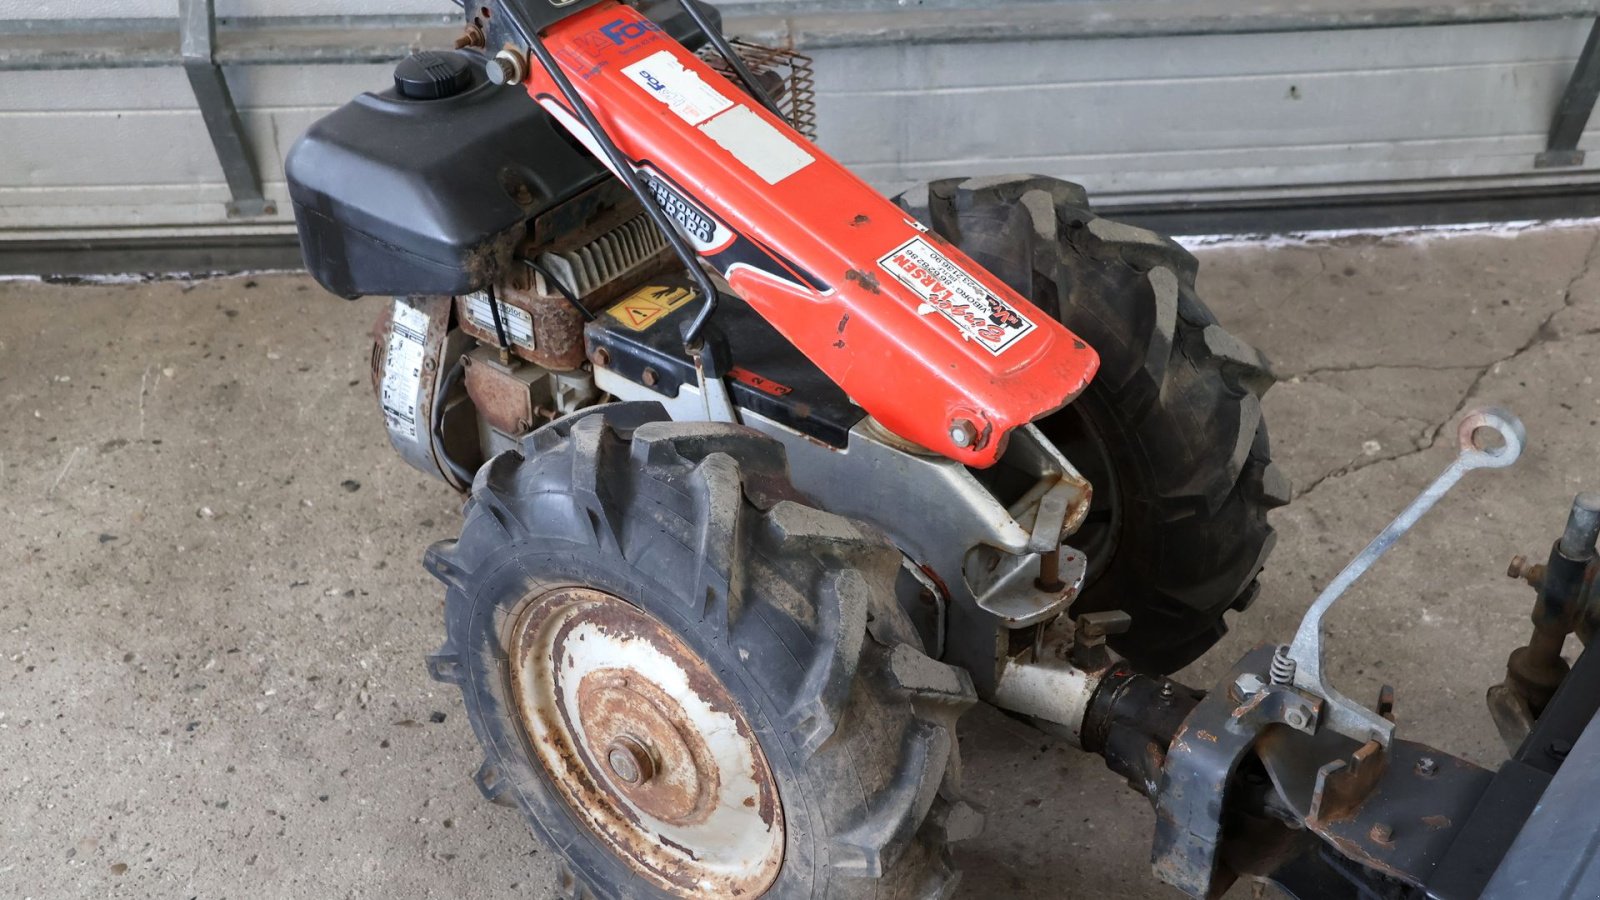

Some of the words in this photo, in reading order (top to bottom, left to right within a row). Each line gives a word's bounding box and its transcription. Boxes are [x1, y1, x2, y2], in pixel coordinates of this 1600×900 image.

[648, 179, 711, 232] ANTONIO
[892, 254, 954, 299] LARSEN
[955, 287, 987, 313] VIBORG
[928, 293, 1005, 343] Birger
